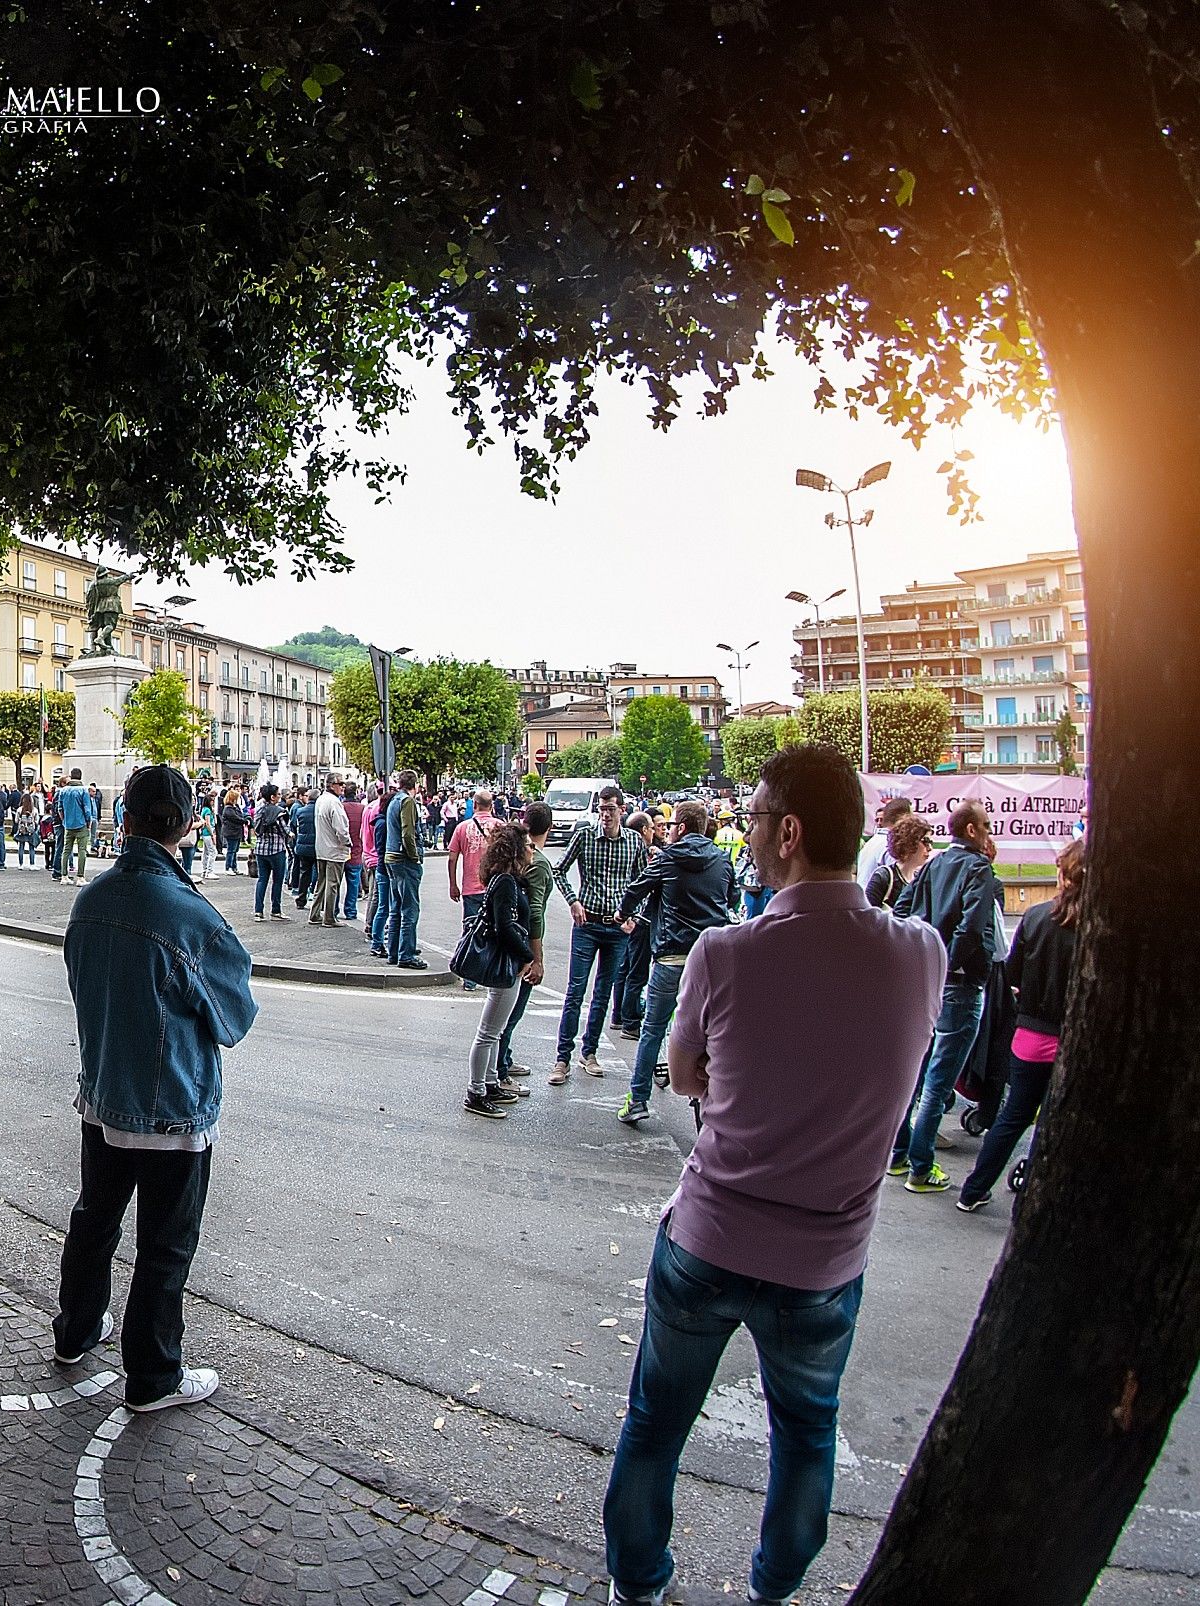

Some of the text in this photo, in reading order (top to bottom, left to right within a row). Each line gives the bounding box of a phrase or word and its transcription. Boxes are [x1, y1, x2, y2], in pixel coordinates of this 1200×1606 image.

[913, 798, 939, 813] La
[1001, 797, 1017, 813] di
[1009, 819, 1045, 835] Giro
